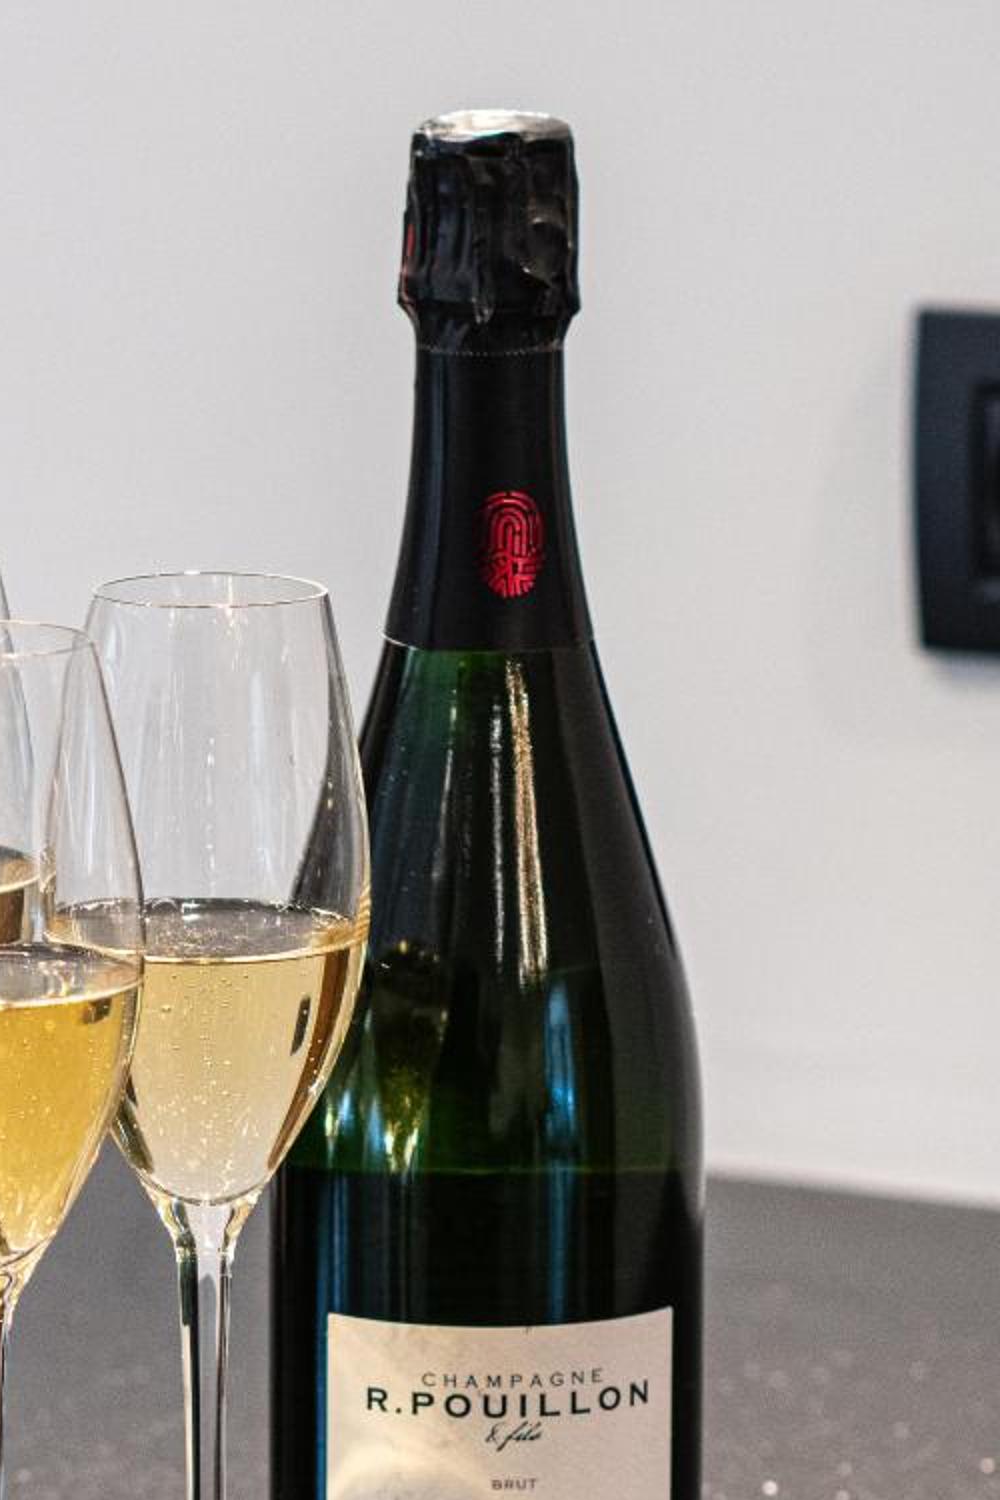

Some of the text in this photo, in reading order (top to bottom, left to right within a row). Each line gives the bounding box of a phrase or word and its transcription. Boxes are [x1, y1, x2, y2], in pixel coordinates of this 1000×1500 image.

[421, 1368, 604, 1389] CHAMPAGNE
[366, 1379, 649, 1418] R.POUILLON
[491, 1478, 537, 1490] BRUT
